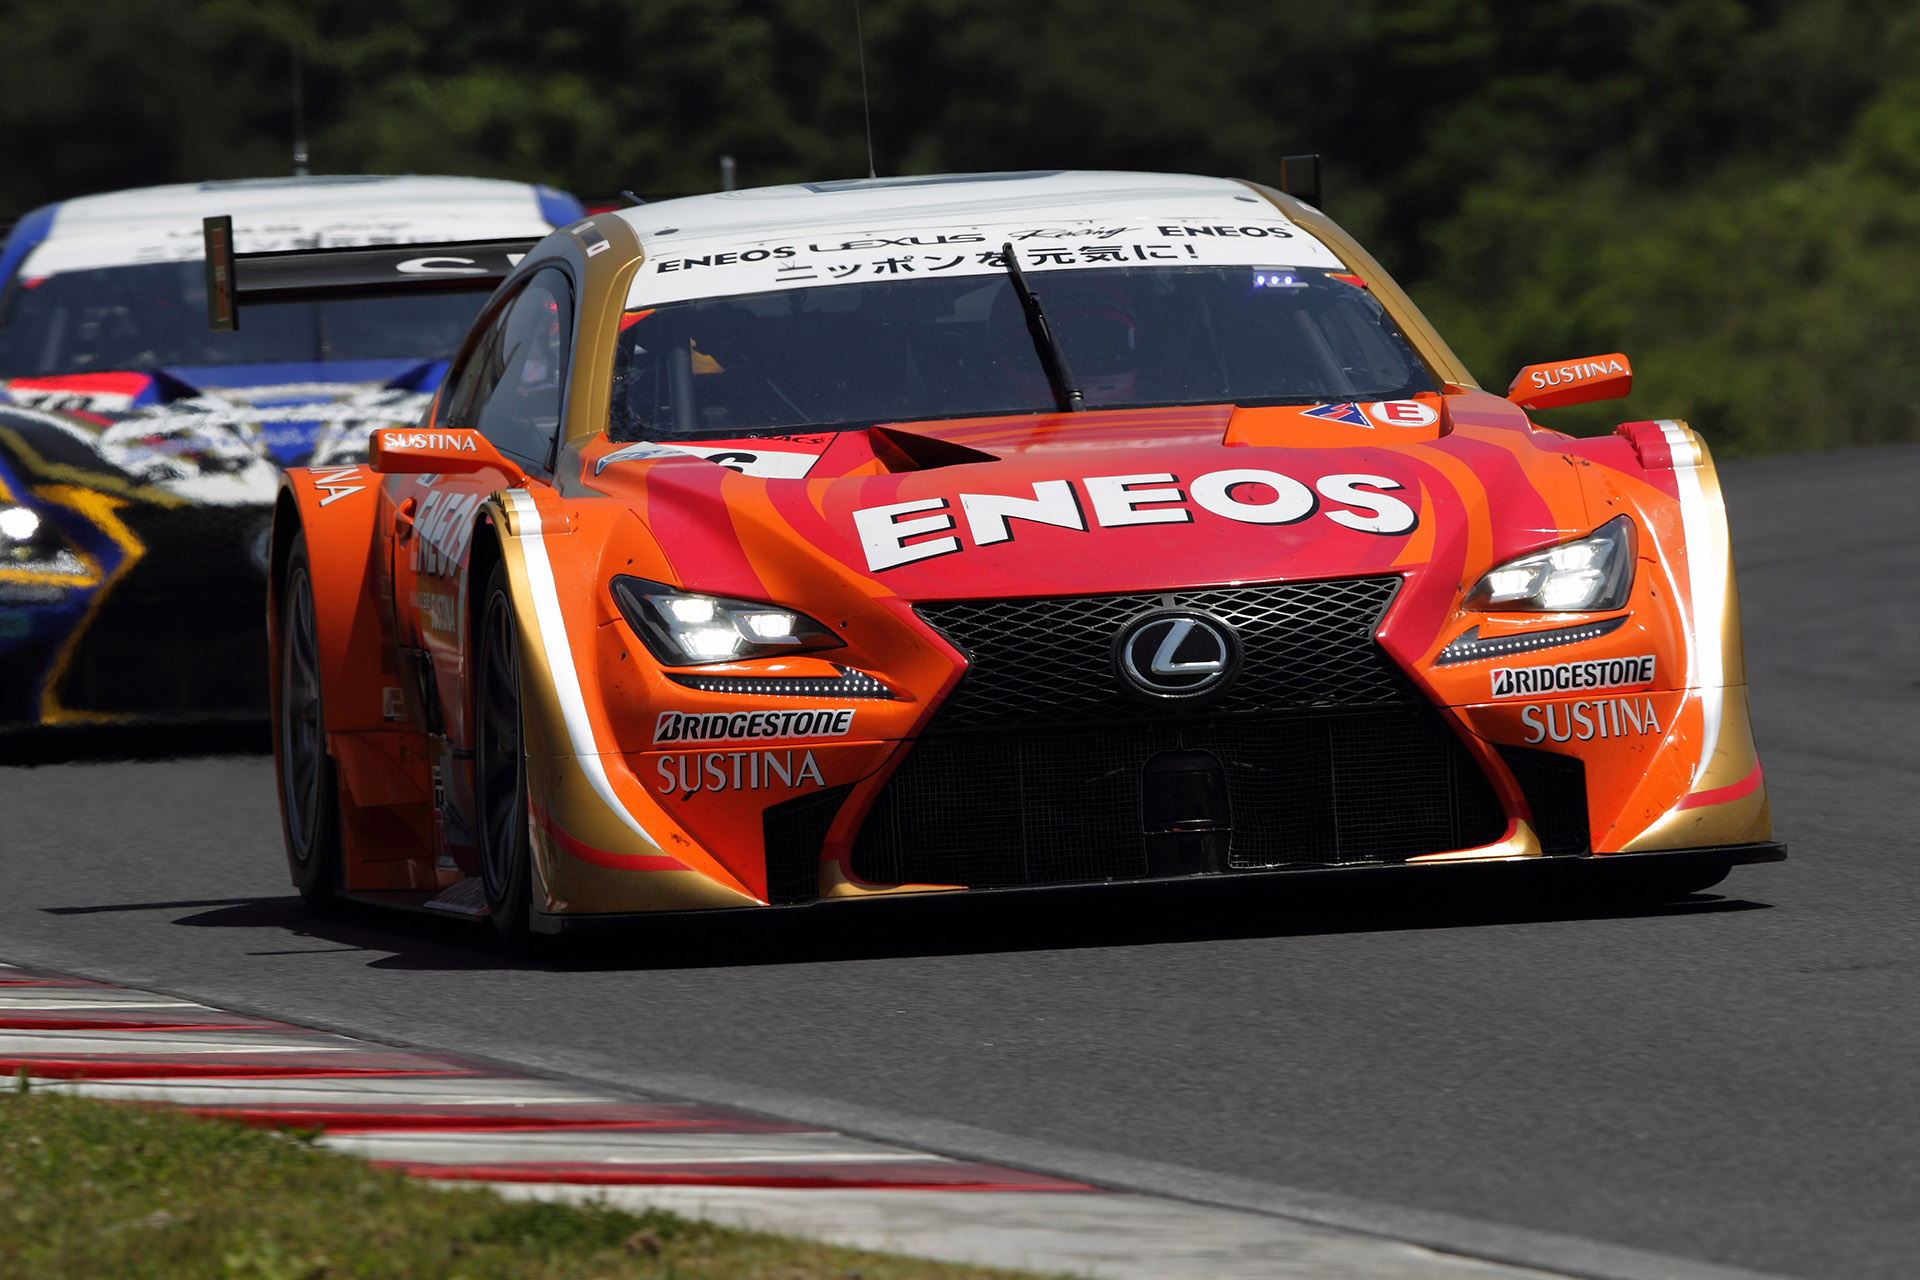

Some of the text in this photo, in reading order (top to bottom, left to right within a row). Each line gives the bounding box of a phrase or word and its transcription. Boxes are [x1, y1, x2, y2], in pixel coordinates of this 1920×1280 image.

[656, 246, 796, 274] ENEOS
[809, 232, 986, 252] LEXUS
[1157, 225, 1294, 239] ENEOS
[1531, 358, 1625, 389] SUSTINA
[383, 433, 478, 452] SUSTINA
[852, 468, 1420, 574] ENEOS
[1492, 657, 1654, 696] BRIDGESTONE
[655, 710, 854, 742] BRIDGESTONE
[1520, 696, 1662, 744] SUSTINA
[656, 749, 826, 794] SUSTINA
